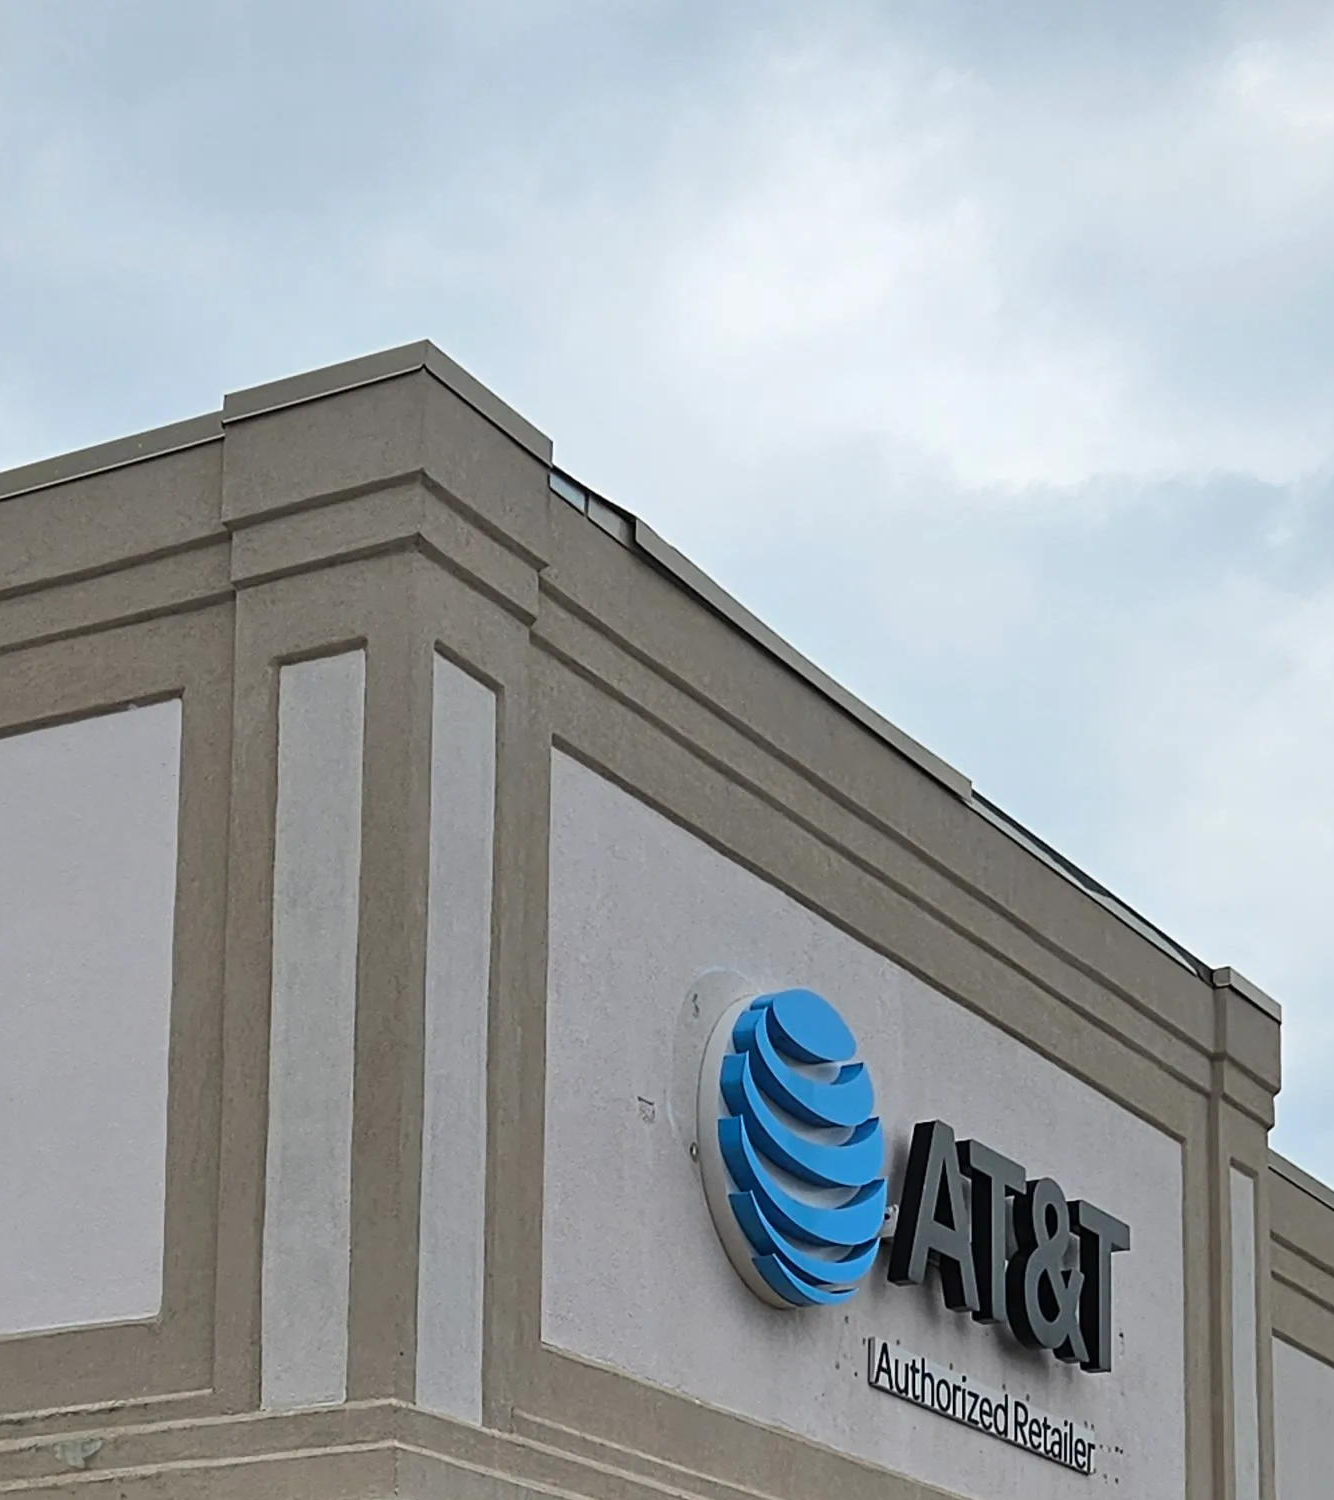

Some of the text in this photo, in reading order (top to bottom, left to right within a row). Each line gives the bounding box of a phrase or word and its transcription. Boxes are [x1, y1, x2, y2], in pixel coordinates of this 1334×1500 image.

[887, 1120, 1130, 1373] AT&T
[875, 1343, 1096, 1473] Authorized Retailer
